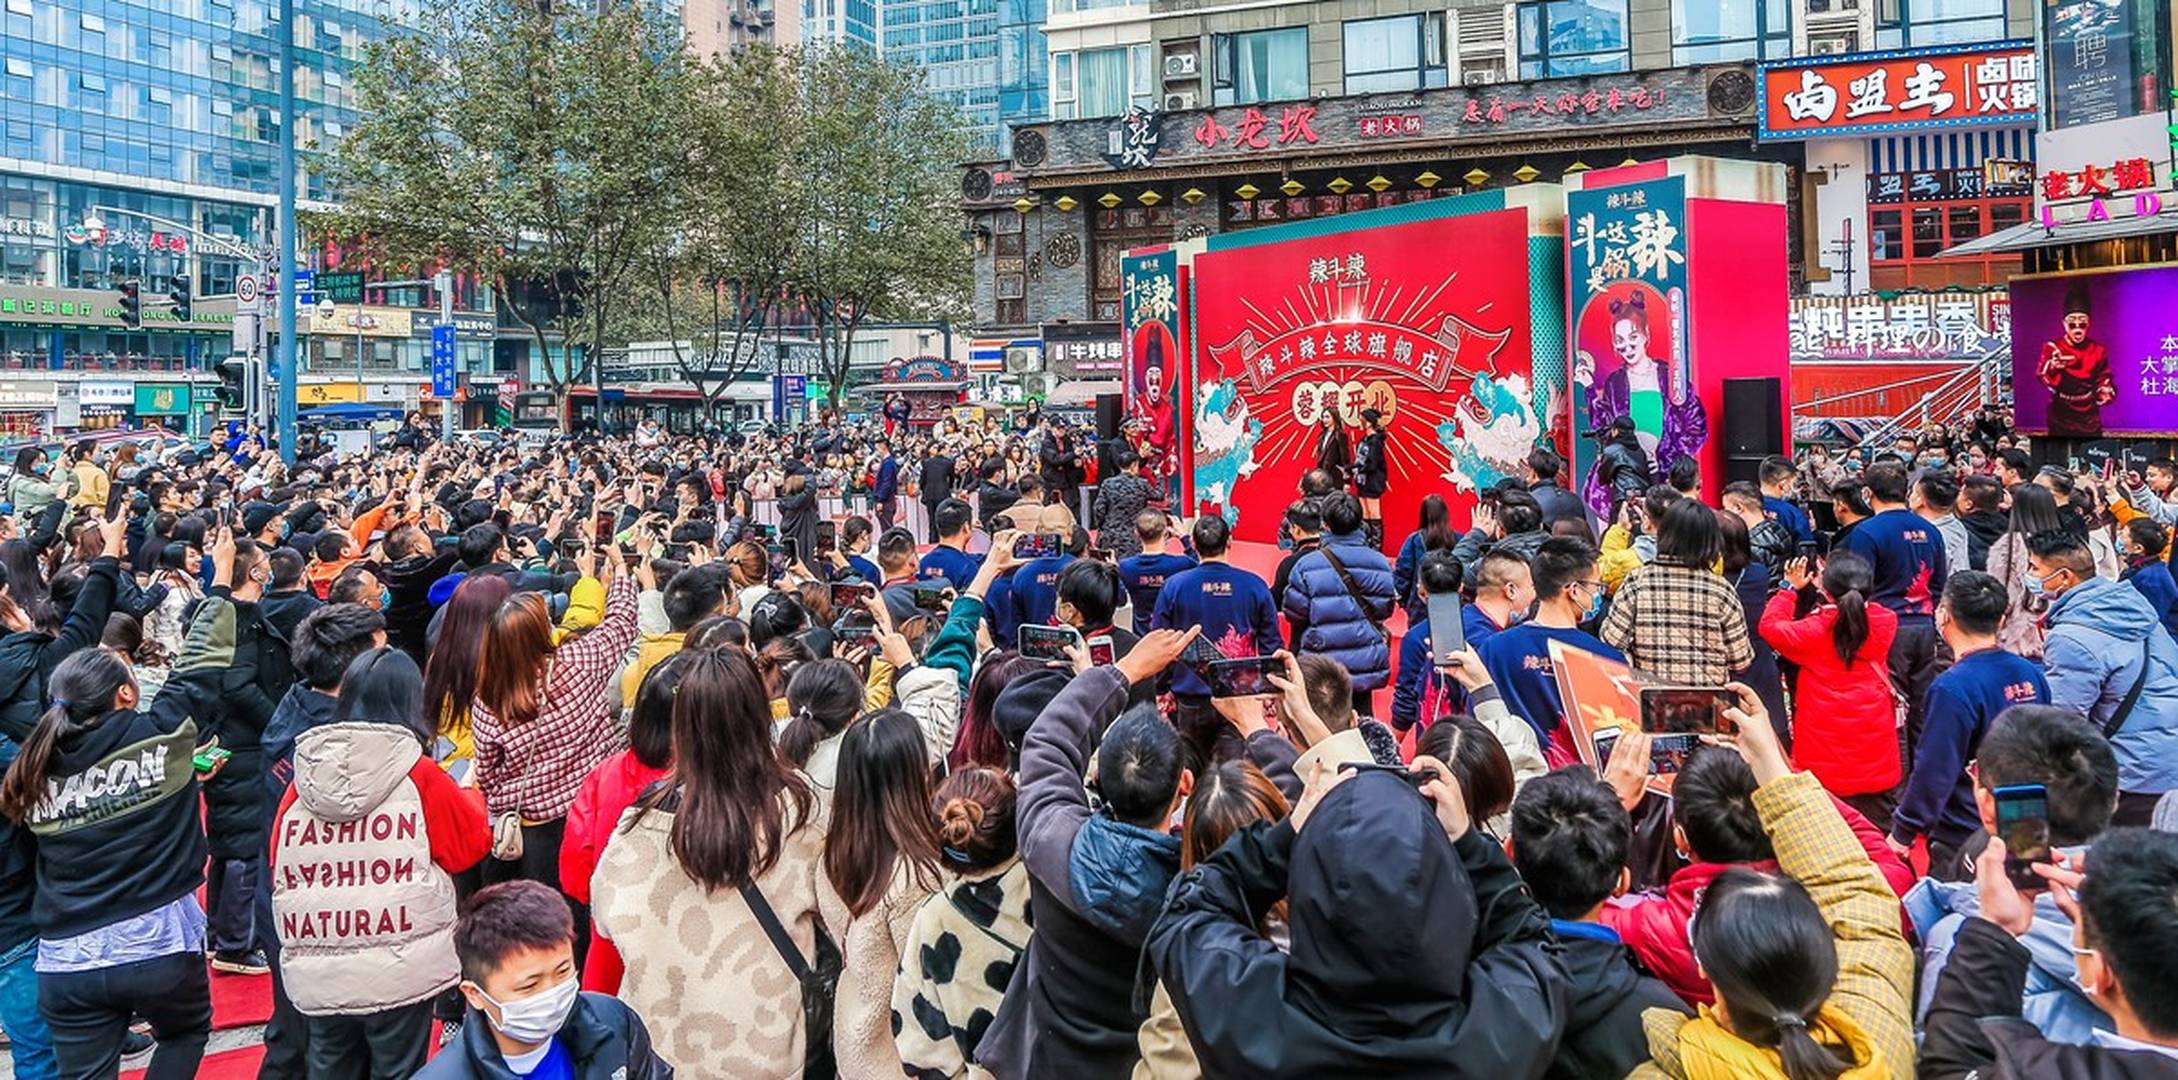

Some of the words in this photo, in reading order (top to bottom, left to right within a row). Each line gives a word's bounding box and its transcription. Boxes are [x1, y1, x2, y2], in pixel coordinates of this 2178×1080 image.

[1975, 53, 2036, 84] 卤味
[2074, 32, 2107, 70] 聘
[1783, 61, 1955, 124] 卤盟主
[1977, 82, 2037, 113] 火锅
[1194, 105, 1320, 150] 小龙坎
[2041, 157, 2153, 200] 老火锅
[1308, 252, 1368, 285] 辣斗辣
[241, 280, 253, 296] 60
[284, 812, 417, 848] FASHION
[282, 905, 413, 939] NATURAL
